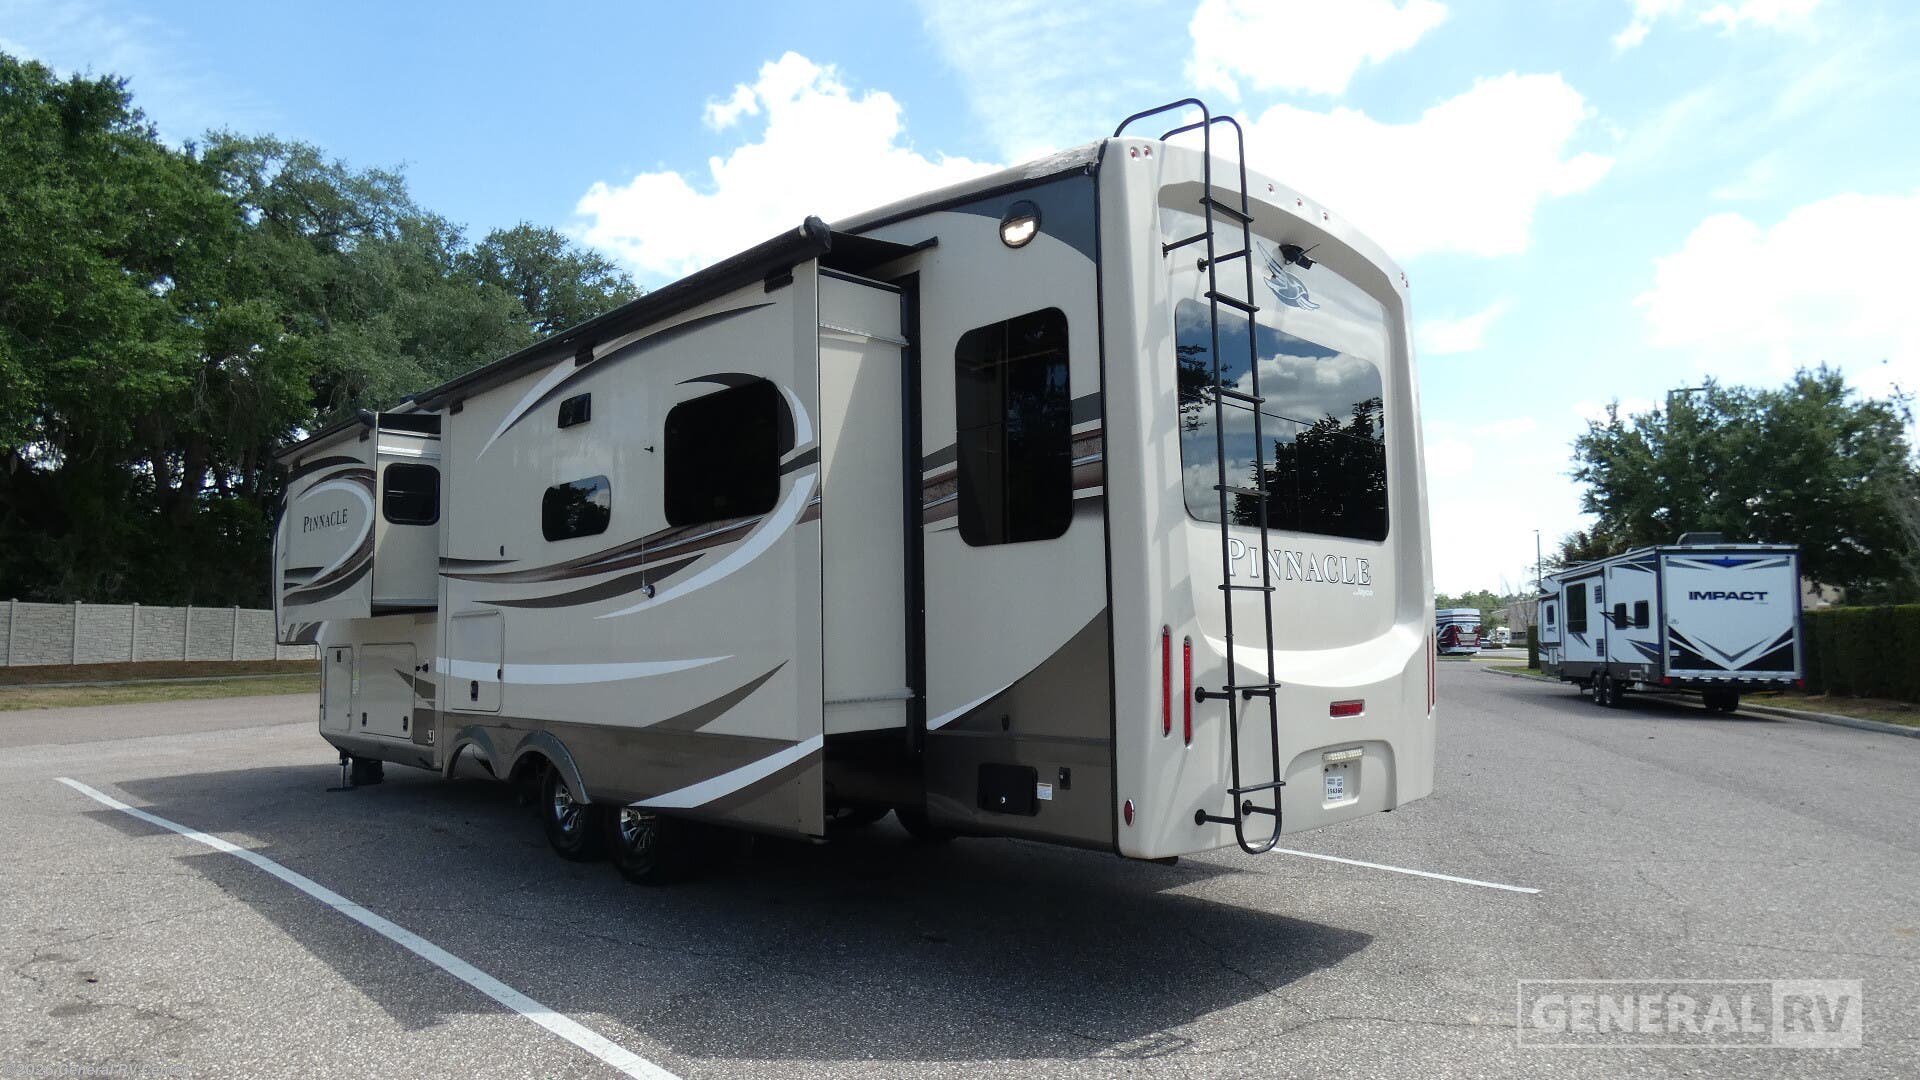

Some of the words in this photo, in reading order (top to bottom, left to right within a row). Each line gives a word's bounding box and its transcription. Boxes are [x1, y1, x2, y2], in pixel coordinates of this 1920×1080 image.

[303, 508, 348, 533] PINNACLE
[1225, 537, 1372, 586] PINNACLE
[1688, 591, 1768, 601] IMPACT
